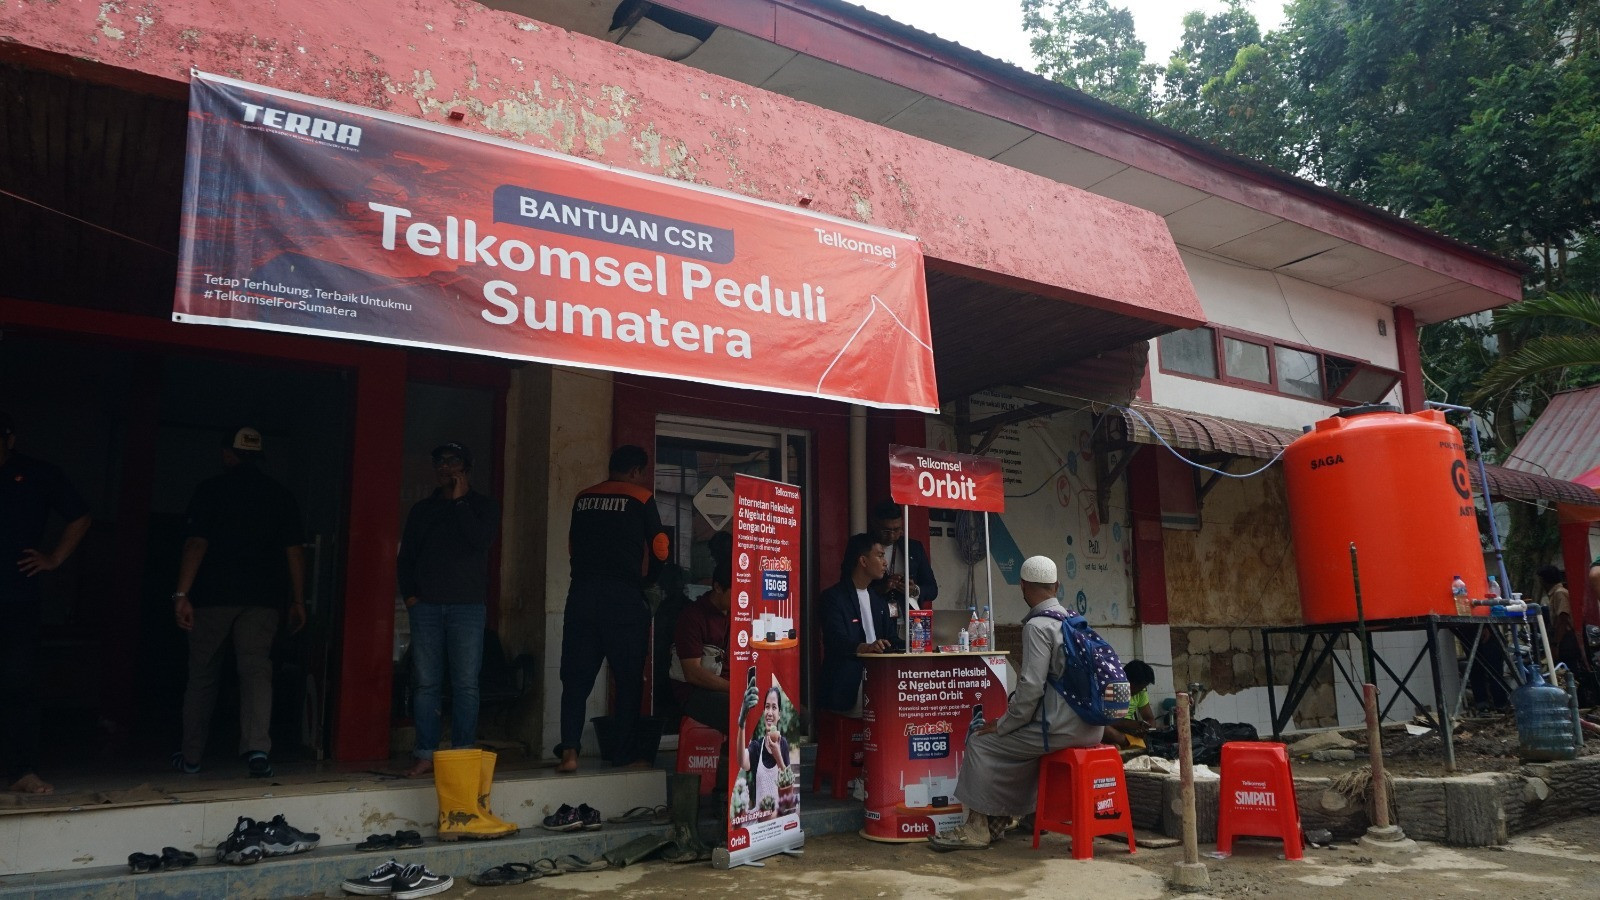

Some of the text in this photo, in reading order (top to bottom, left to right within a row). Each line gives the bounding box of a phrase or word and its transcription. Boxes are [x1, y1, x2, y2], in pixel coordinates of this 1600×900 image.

[240, 102, 362, 146] TERRA
[519, 195, 714, 253] BANTUAN CSR
[814, 227, 897, 260] Telkomsel
[368, 201, 827, 323] Telkomsel Peduli
[204, 273, 412, 312] Tetap Terhubung, Terbaik Untukmu
[203, 289, 357, 318] #TelkomselForSumatera
[481, 280, 753, 360] Sumatera
[916, 456, 962, 472] Telkomsel
[1310, 454, 1344, 470] SAGA
[775, 486, 800, 500] Telkomsel
[918, 471, 977, 501] Orbit
[577, 497, 629, 512] SECURITY
[738, 495, 794, 515] Internetan Fleksibel
[744, 508, 766, 521] Ngebut
[738, 520, 776, 535] Dengan Orbit
[759, 556, 792, 571] FantaSix
[765, 579, 787, 592] 150 GB
[898, 667, 987, 679] Internetan Fleksibel
[898, 679, 991, 692] & Ngebut di mana aja
[898, 691, 964, 703] Dengan Orbit
[904, 720, 954, 736] FantaSix
[912, 741, 947, 752] 150 GB
[688, 755, 720, 768] SIMPAT
[1096, 798, 1114, 811] SIMPATI
[1235, 791, 1276, 807] SIMPATI
[902, 823, 929, 833] Orbit
[731, 835, 747, 848] Orbit
